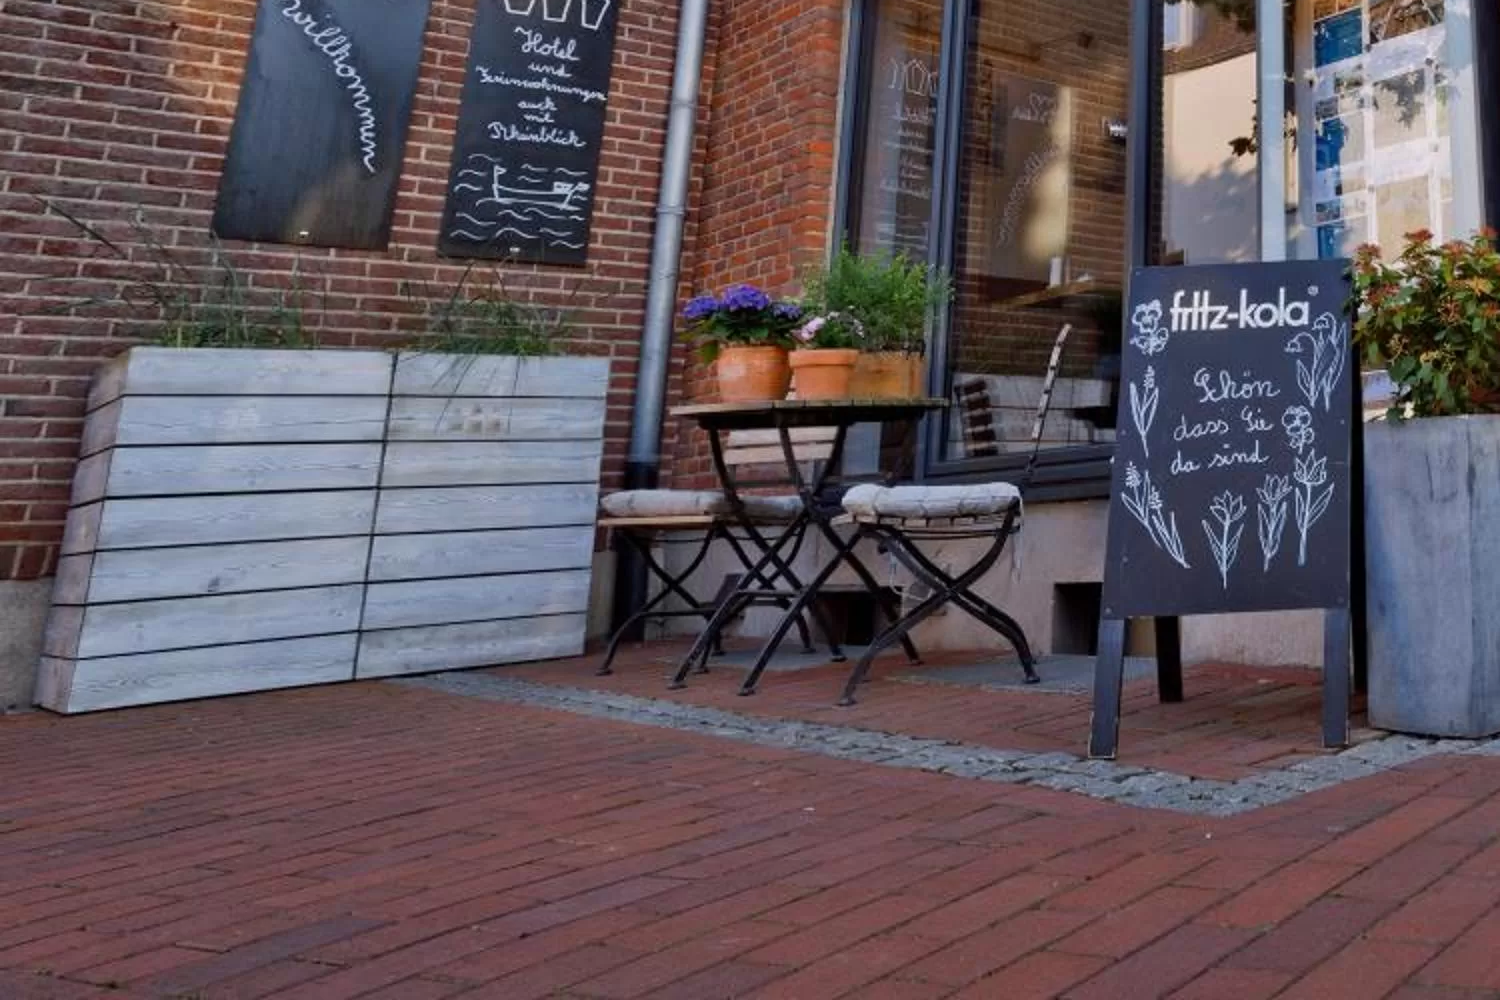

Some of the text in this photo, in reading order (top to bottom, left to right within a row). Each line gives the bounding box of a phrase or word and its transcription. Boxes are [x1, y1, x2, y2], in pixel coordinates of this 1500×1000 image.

[513, 26, 582, 61] Hotel
[527, 62, 573, 78] und
[517, 96, 558, 111] auch
[523, 111, 555, 123] mit
[487, 121, 588, 147] Rheinblick
[1169, 286, 1310, 333] fritz-kola
[1193, 367, 1281, 404] Schön
[1173, 404, 1275, 441] dass Sie
[1170, 439, 1271, 476] da sind
